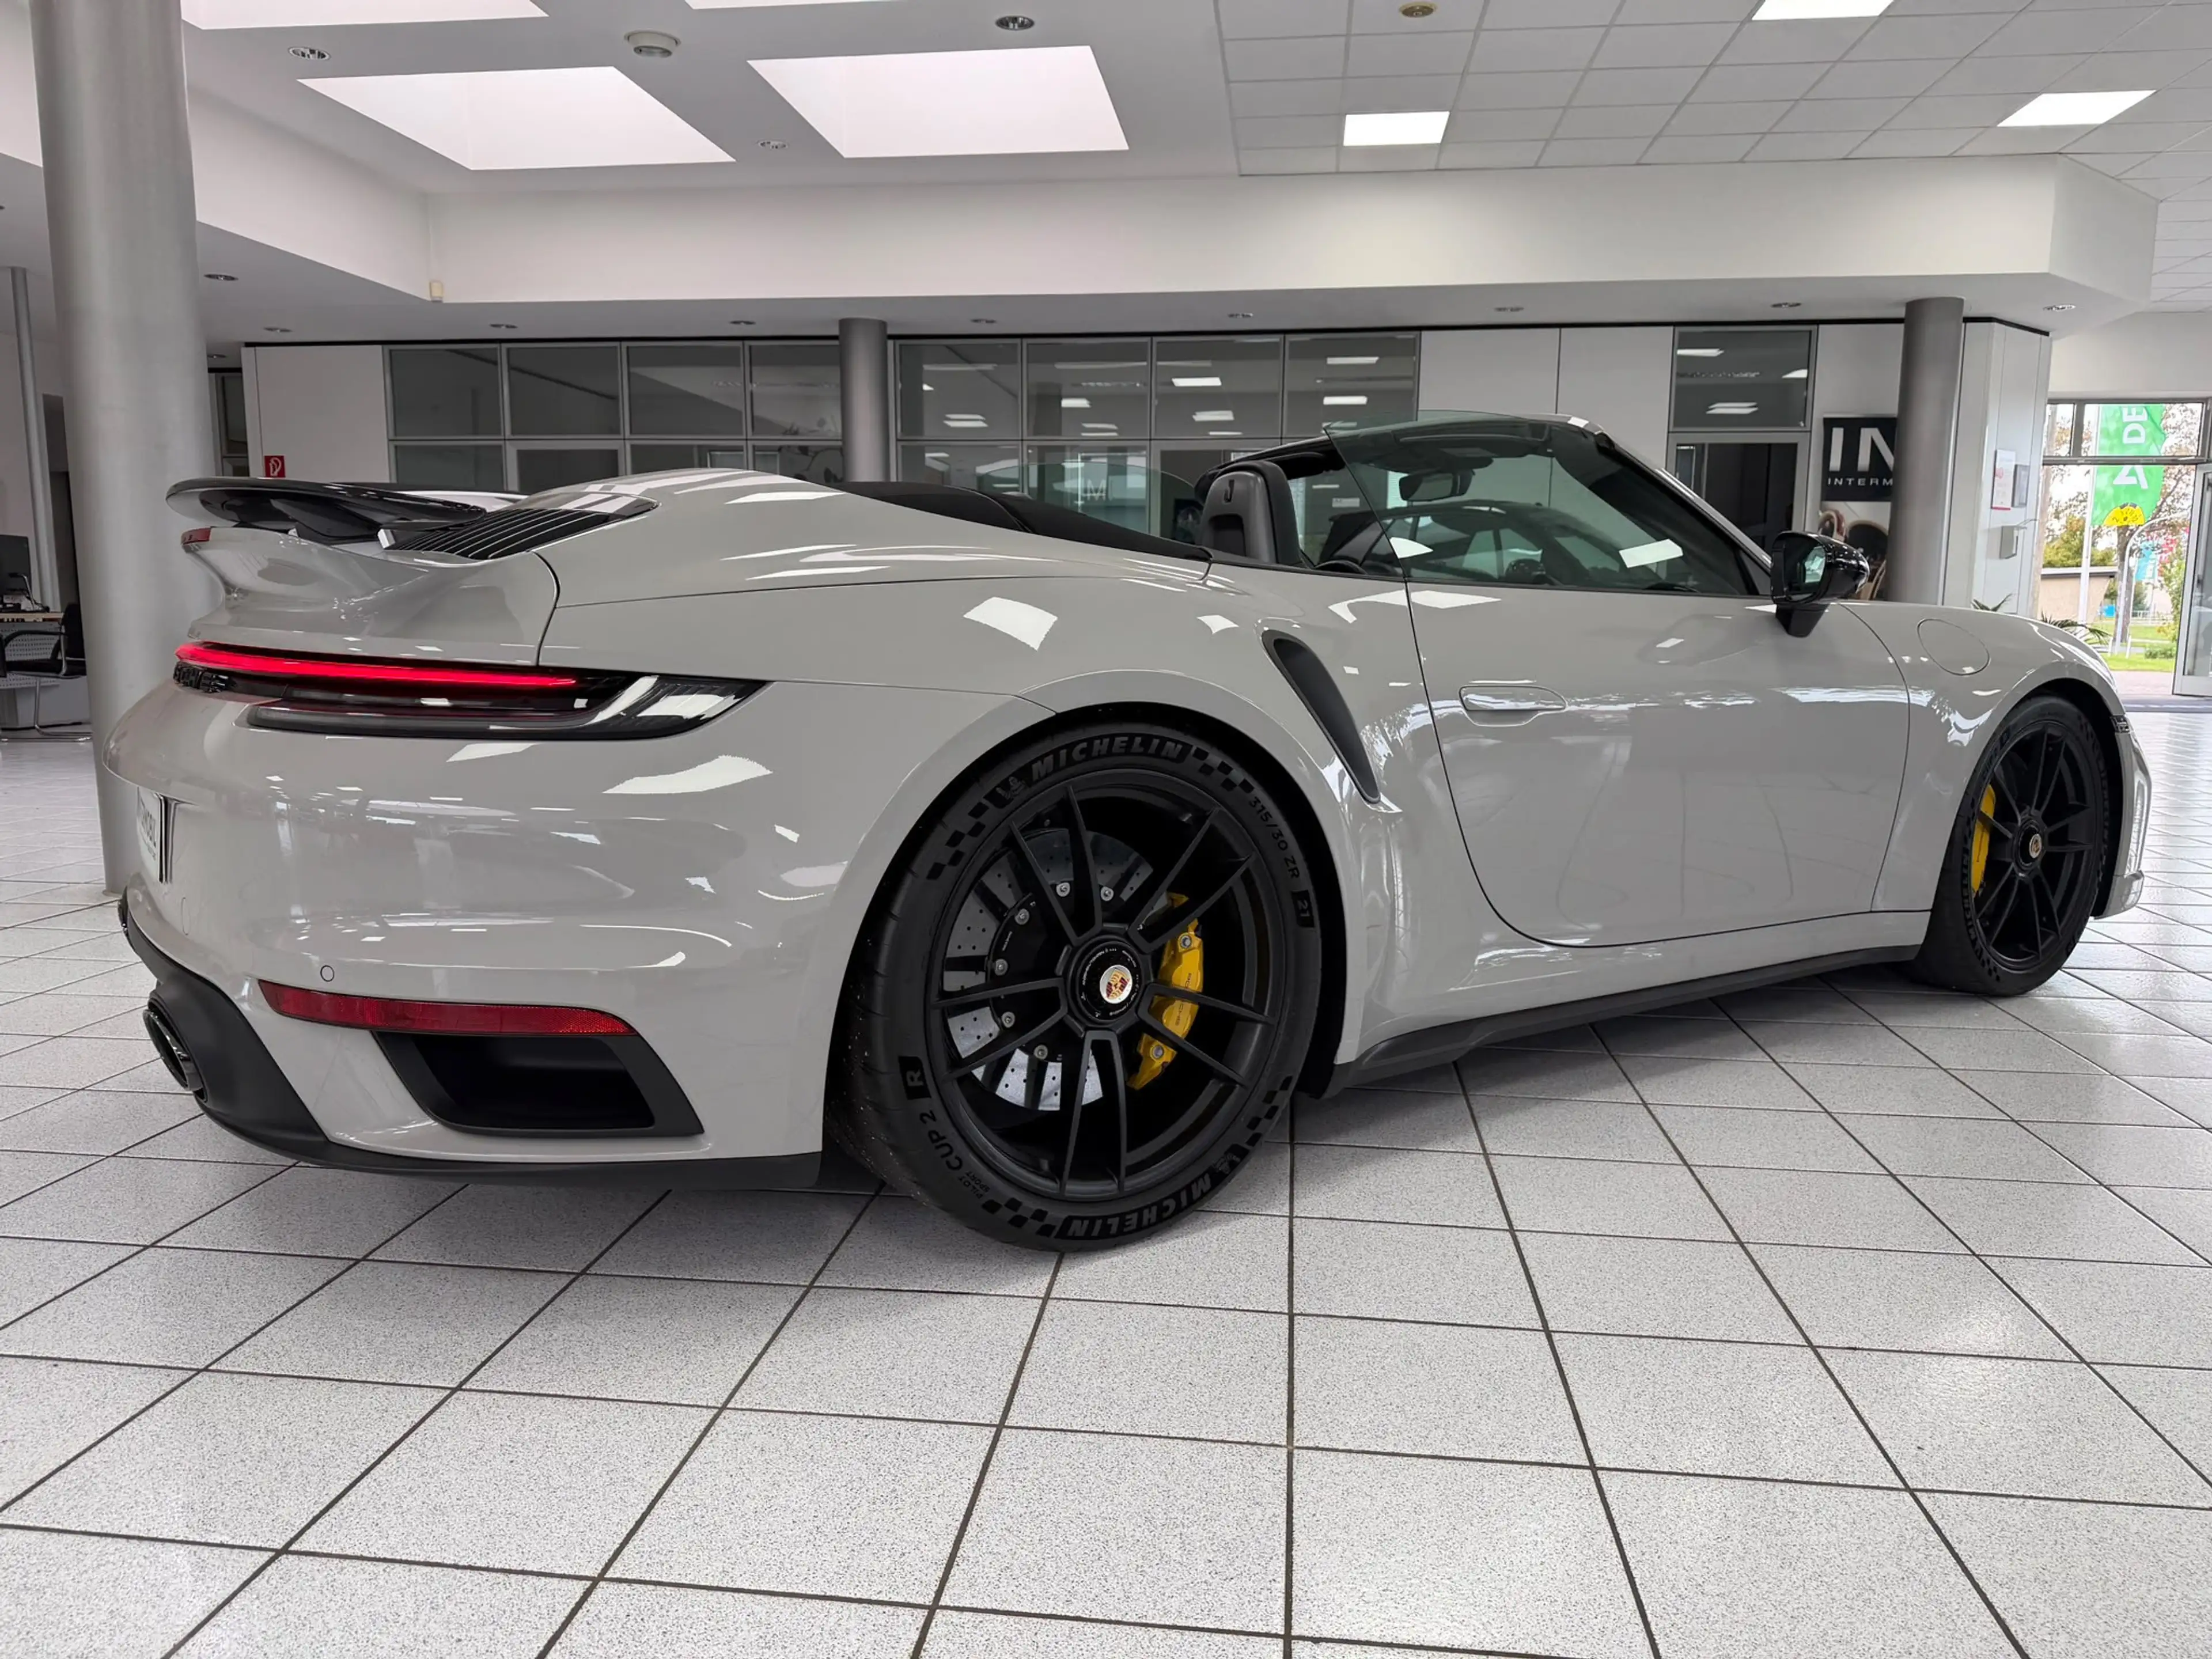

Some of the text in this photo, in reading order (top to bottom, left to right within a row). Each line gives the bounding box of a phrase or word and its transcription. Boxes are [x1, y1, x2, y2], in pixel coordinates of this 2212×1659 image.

[1829, 427, 1895, 472] IN
[1828, 478, 1893, 486] INTERM
[1031, 734, 1183, 782] MICHELIN
[1249, 796, 1311, 917] 315/30 ZR 21
[906, 1068, 963, 1171] CUP 2 R
[1066, 1172, 1212, 1237] MICHELIN
